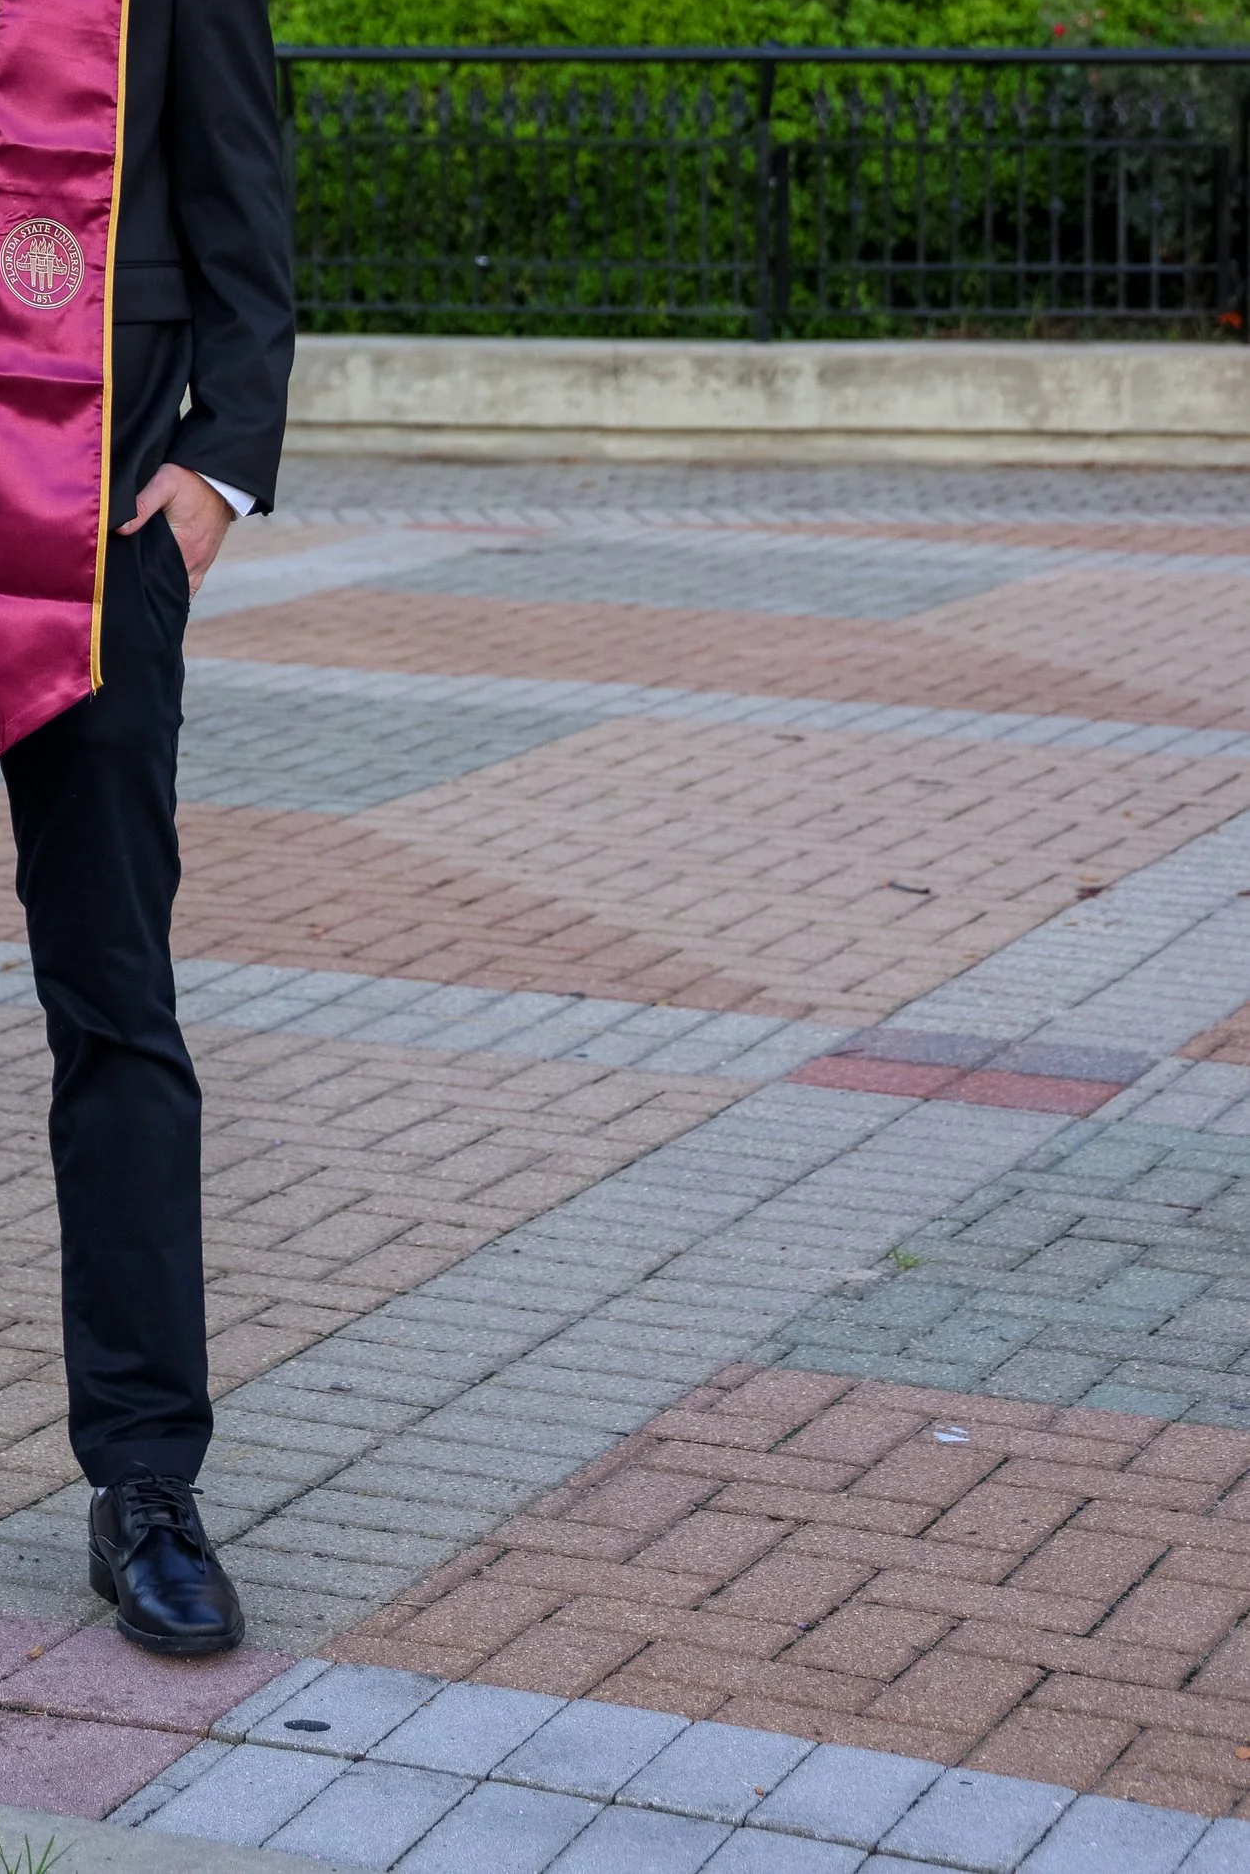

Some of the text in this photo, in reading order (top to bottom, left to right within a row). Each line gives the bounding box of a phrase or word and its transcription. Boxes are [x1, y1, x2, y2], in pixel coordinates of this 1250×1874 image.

[5, 223, 80, 290] FLORIDA STATE UNIVERSITY
[32, 293, 53, 304] 1851
